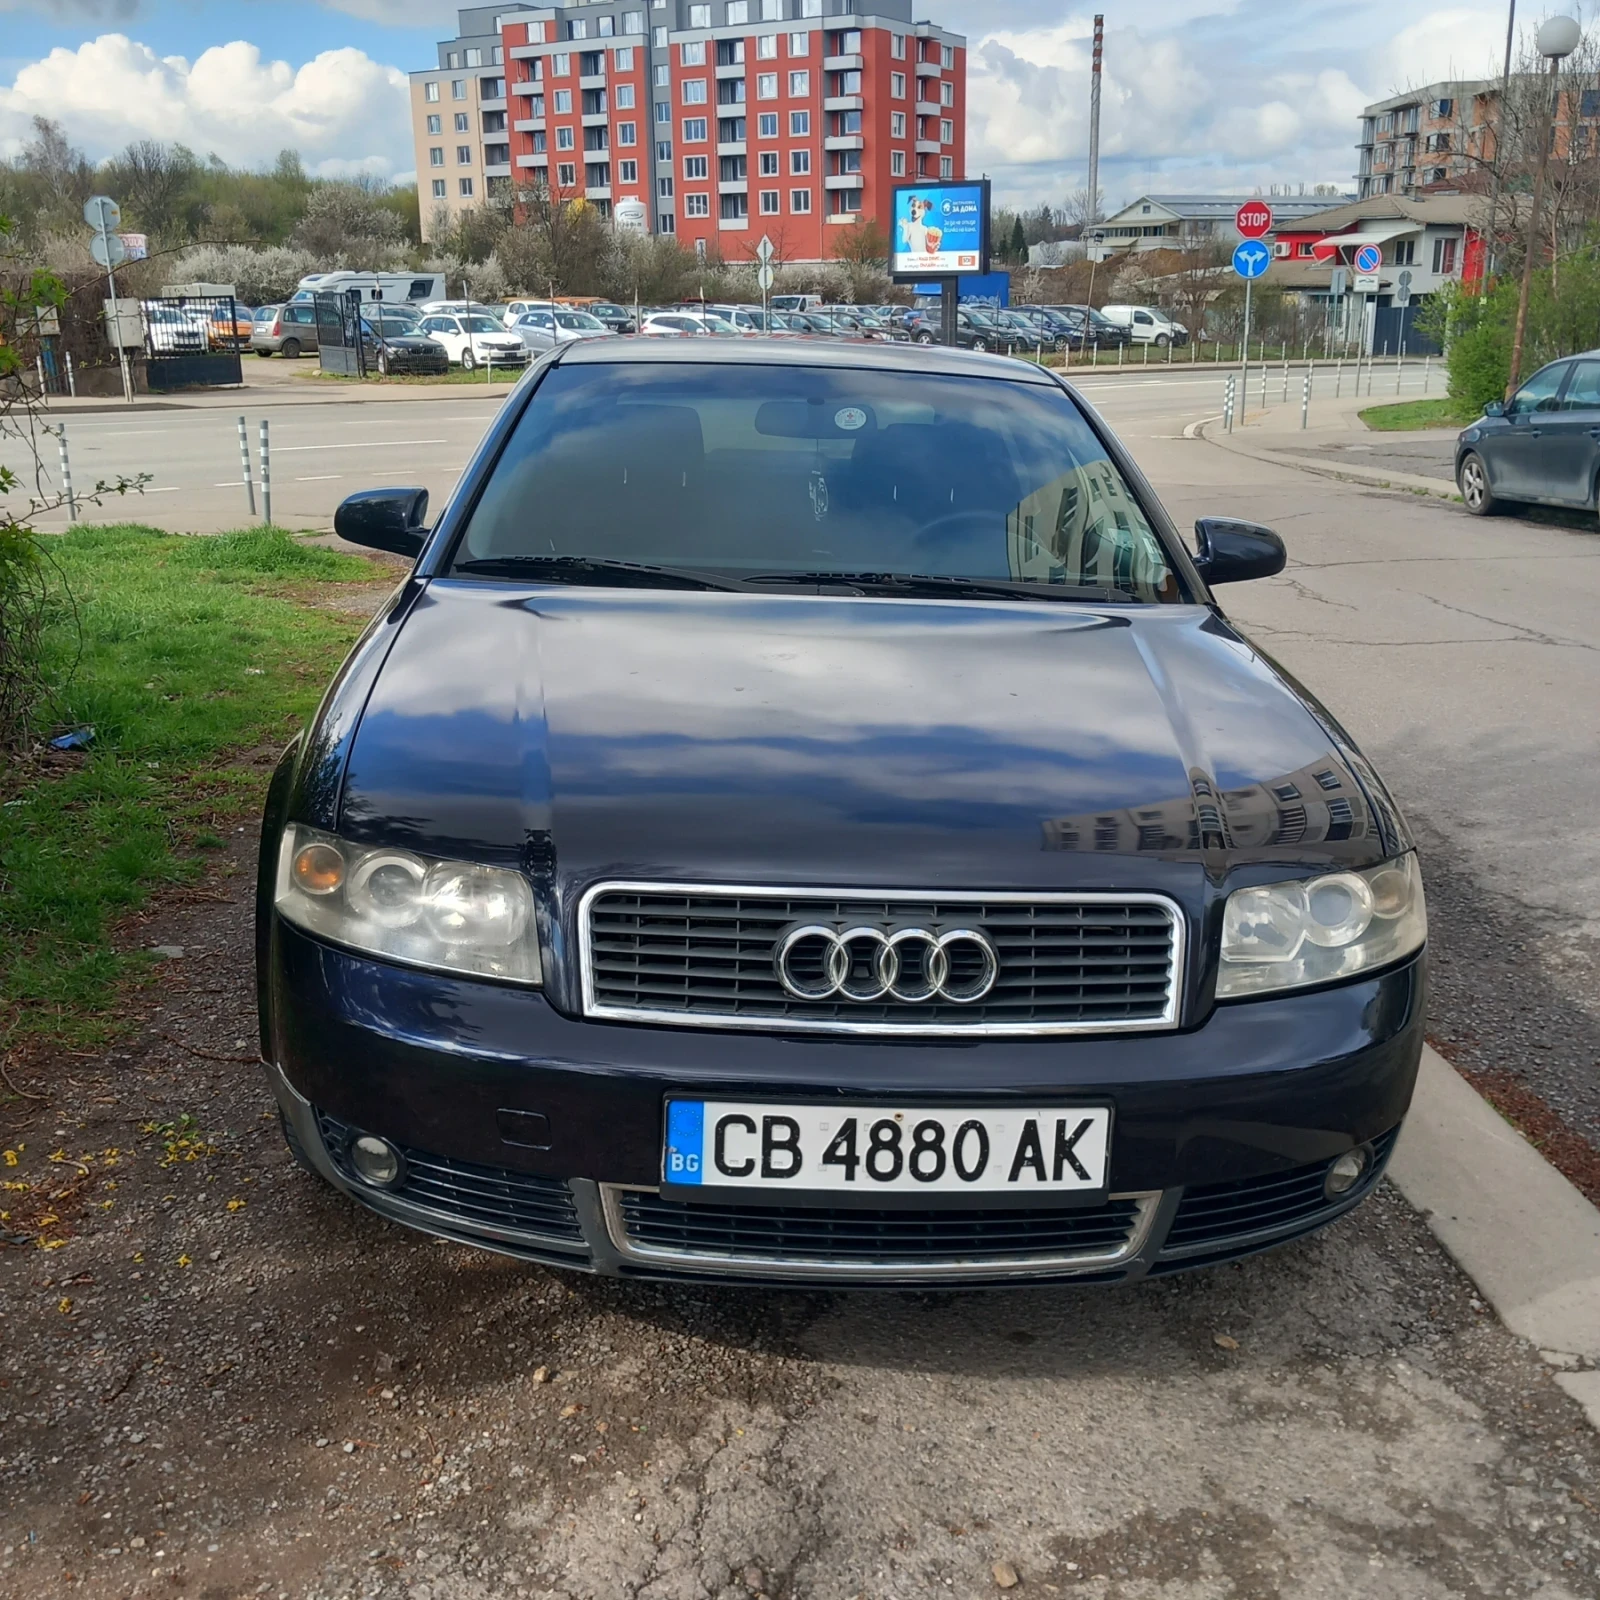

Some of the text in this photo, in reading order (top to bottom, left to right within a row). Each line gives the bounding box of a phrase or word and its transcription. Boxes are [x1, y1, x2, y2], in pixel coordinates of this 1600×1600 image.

[960, 205, 977, 213] ДОМА
[1239, 212, 1268, 227] STOP
[671, 1113, 1096, 1183] BG CB 4880 AK
